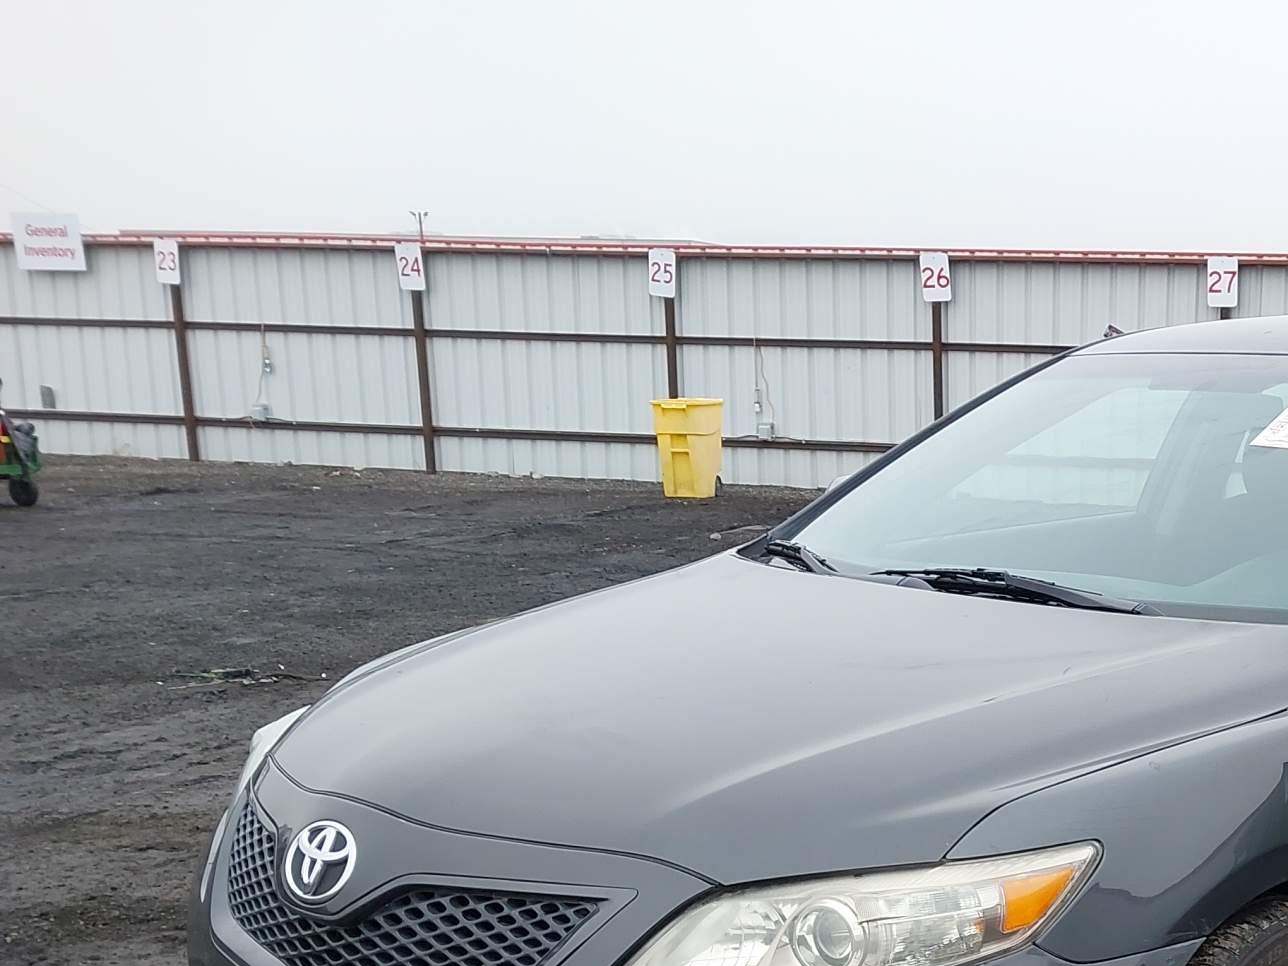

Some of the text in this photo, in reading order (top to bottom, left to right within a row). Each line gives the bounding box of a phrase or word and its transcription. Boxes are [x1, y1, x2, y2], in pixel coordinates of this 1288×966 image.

[25, 224, 68, 237] General
[24, 244, 76, 260] Inventory
[157, 251, 176, 271] 23
[399, 256, 422, 277] 24
[651, 262, 673, 284] 25
[922, 267, 949, 289] 26
[1208, 271, 1237, 293] 27
